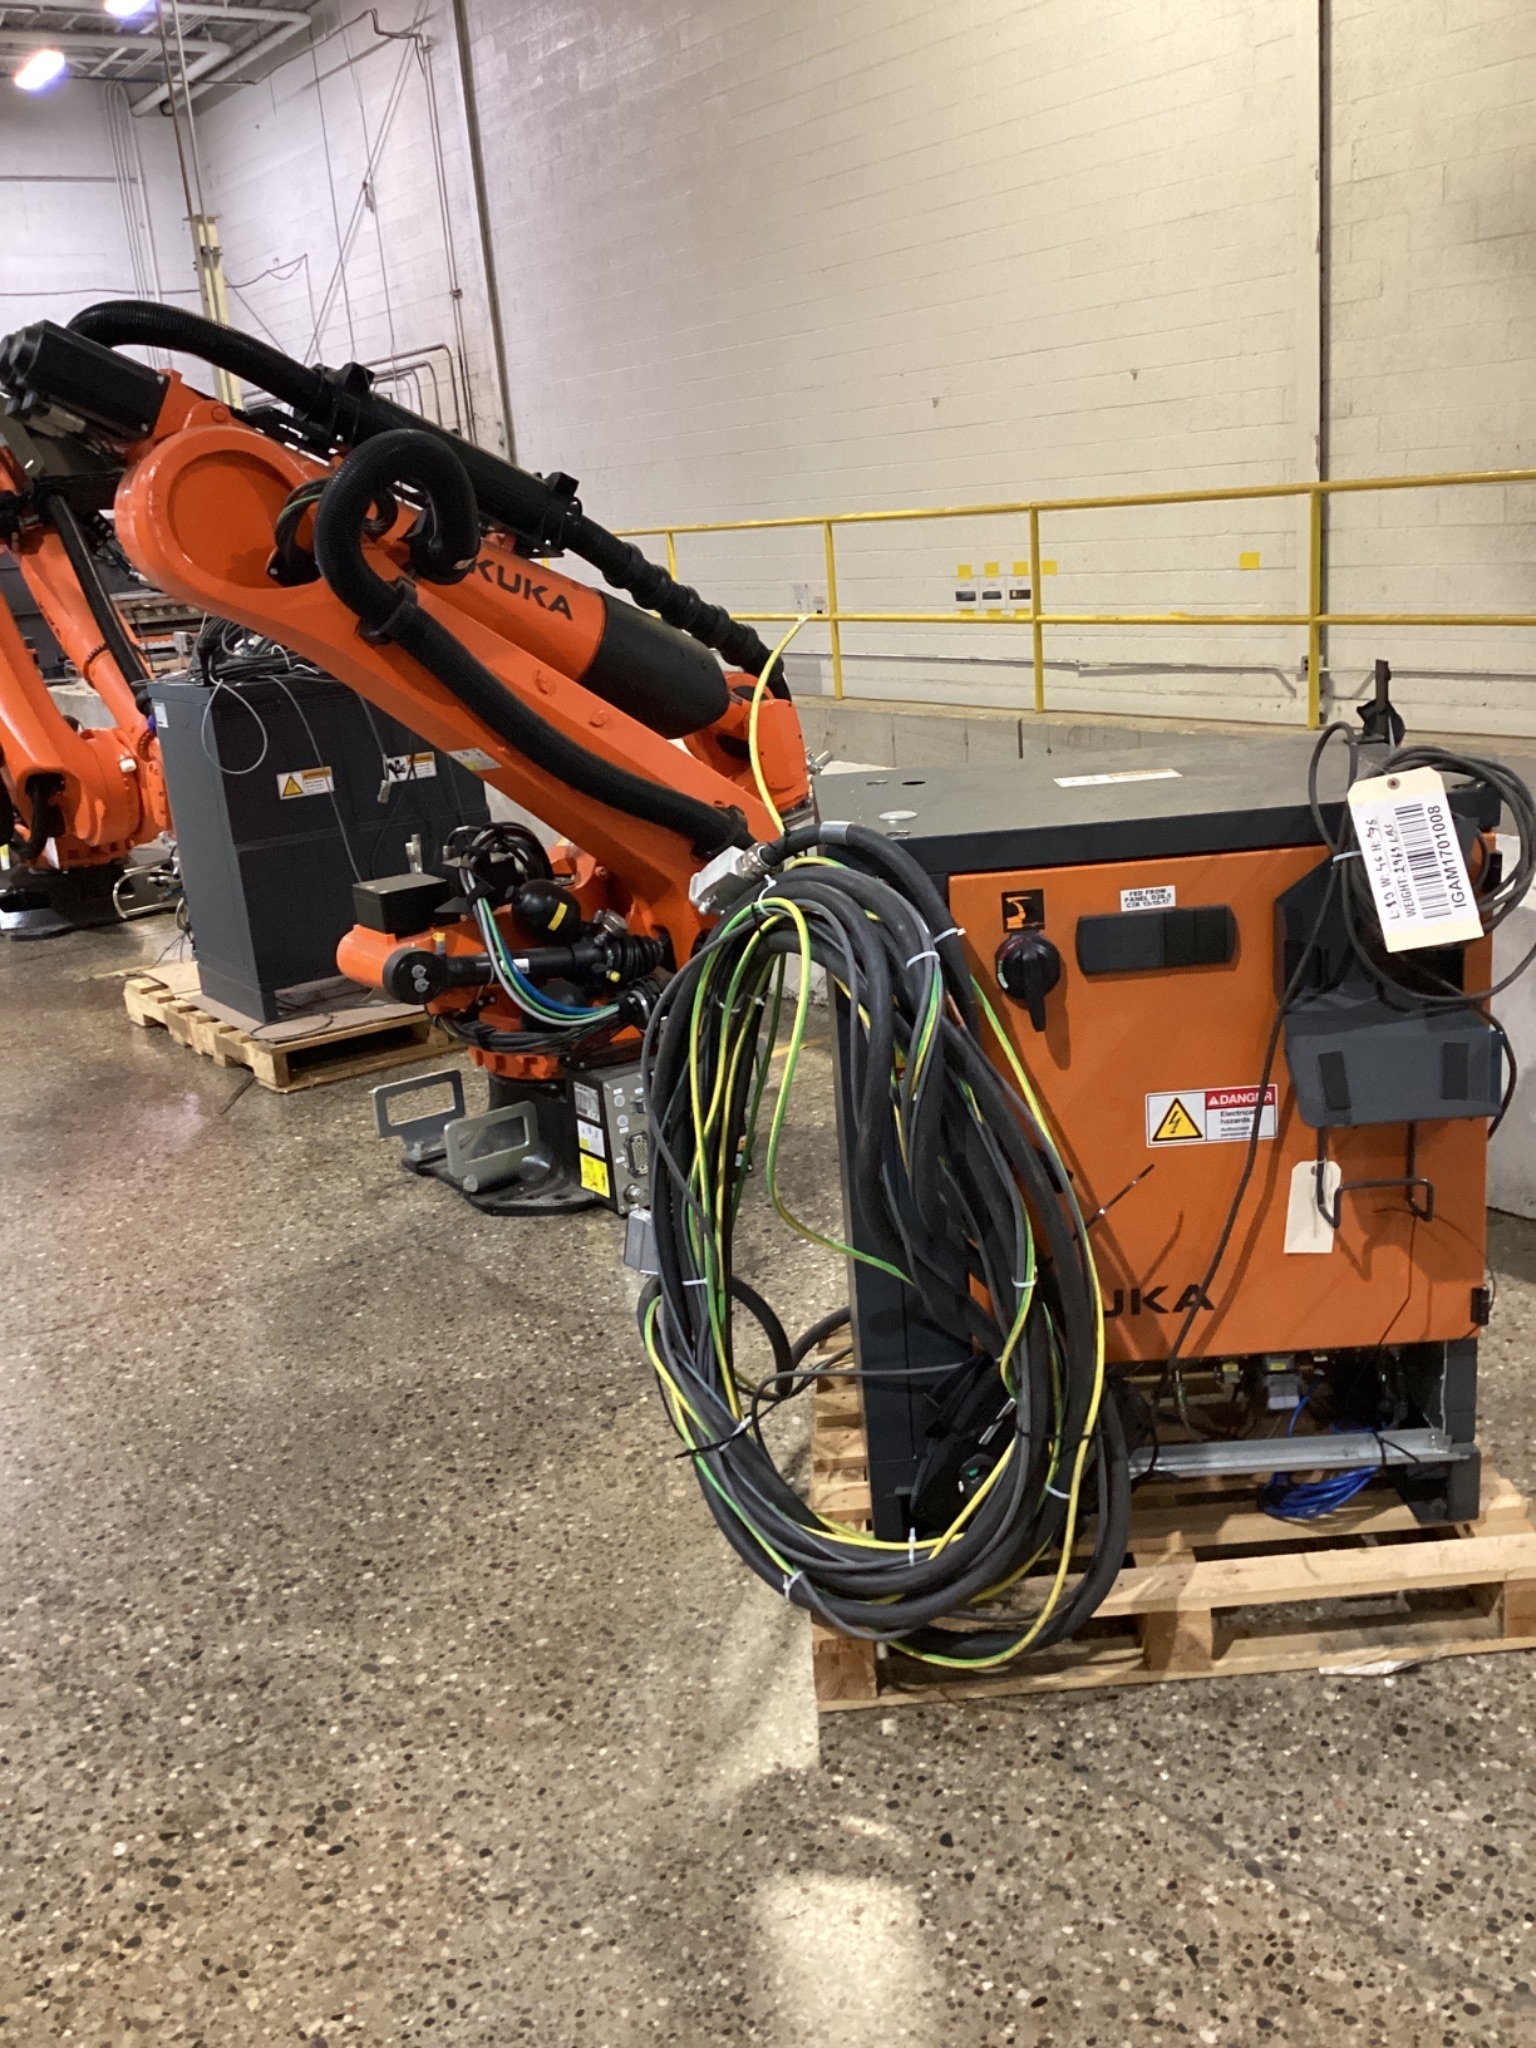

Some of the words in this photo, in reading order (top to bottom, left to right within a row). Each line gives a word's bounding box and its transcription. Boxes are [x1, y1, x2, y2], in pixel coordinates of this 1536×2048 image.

[469, 559, 573, 620] KUKA
[1427, 805, 1467, 908] IGAM1701008
[1397, 875, 1417, 918] WEIGHT:
[1220, 1092, 1272, 1105] DANGR
[1103, 1284, 1216, 1318] UKA
